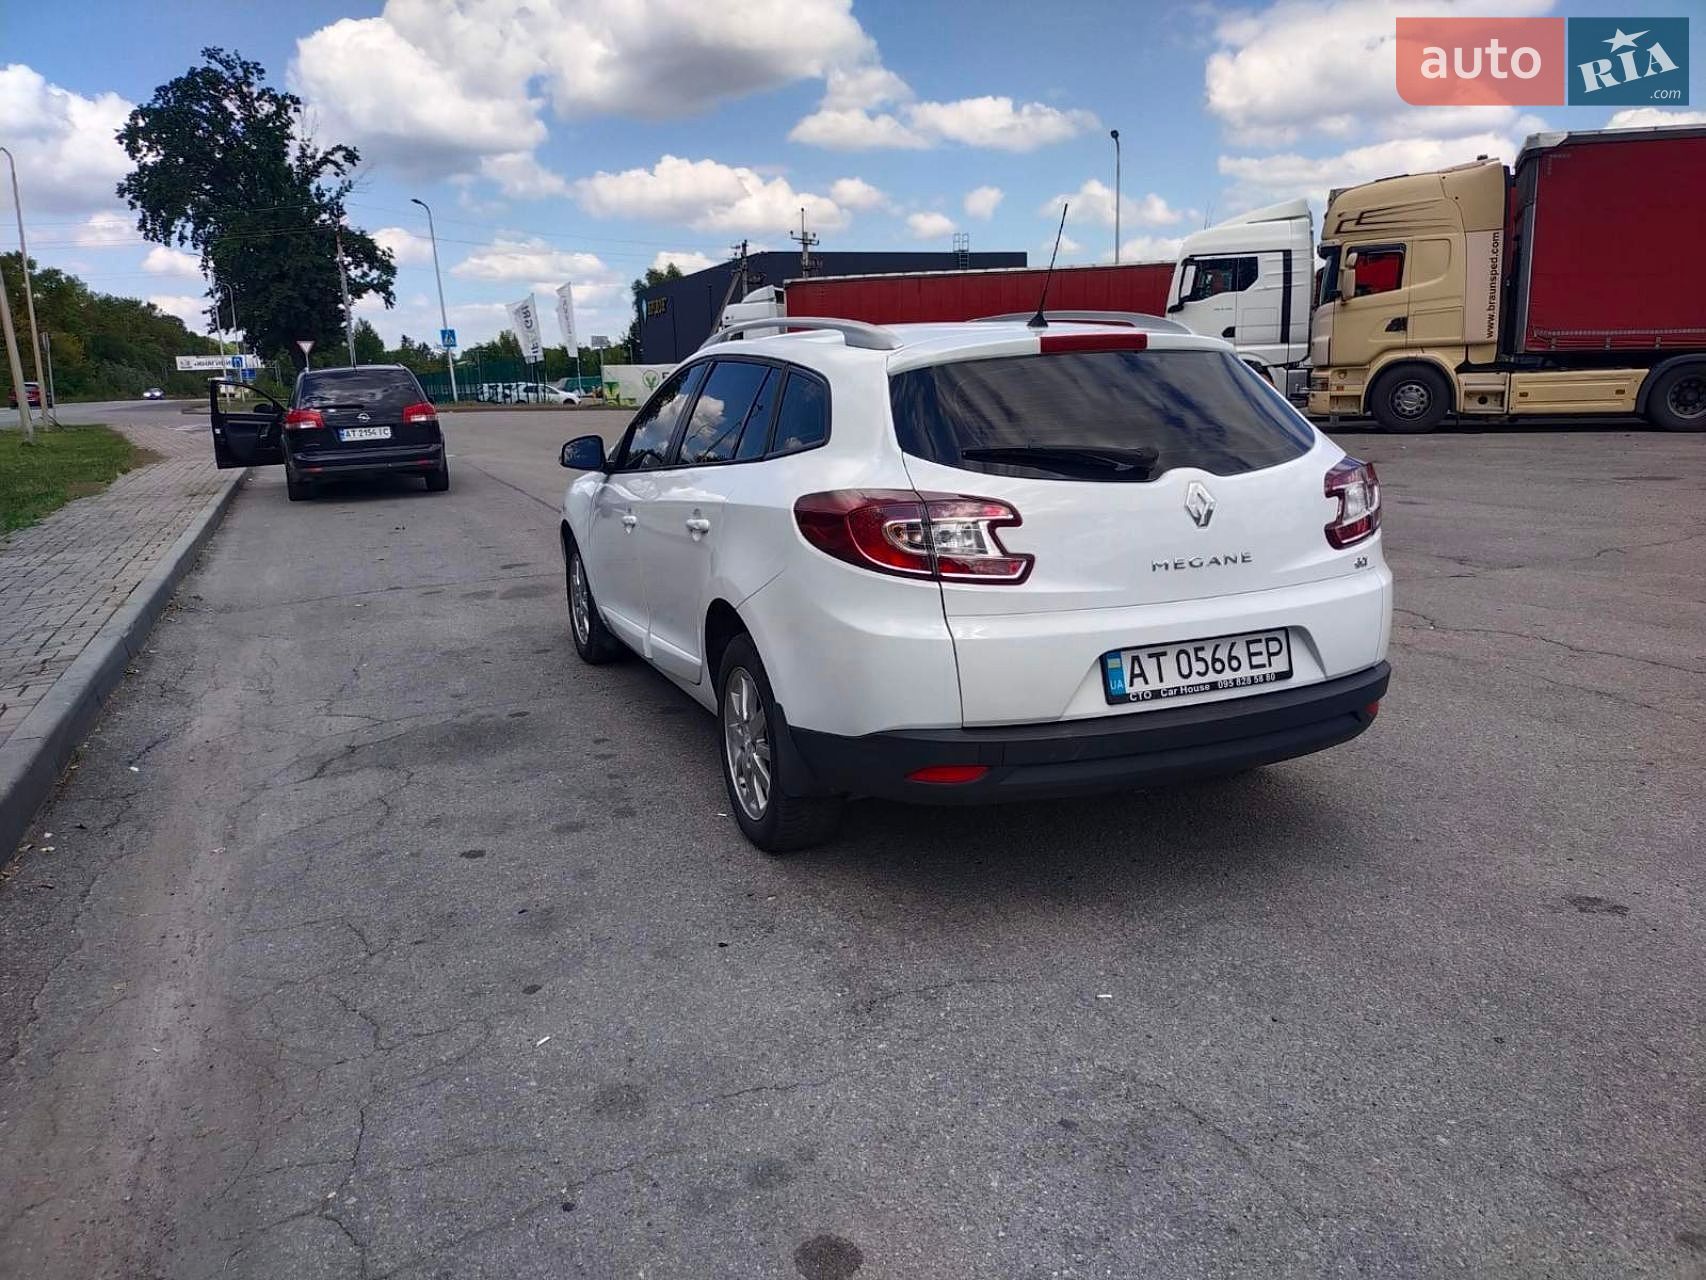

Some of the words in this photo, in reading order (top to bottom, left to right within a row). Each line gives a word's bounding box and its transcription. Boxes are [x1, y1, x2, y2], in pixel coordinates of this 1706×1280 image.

[1487, 231, 1500, 339] www.braunsped.com
[1152, 552, 1253, 571] MEGANE
[1129, 651, 1167, 687] AT
[1175, 642, 1242, 679] 0566
[1245, 636, 1283, 670] EP
[1110, 679, 1124, 690] UA
[1160, 687, 1177, 697] Car
[1180, 683, 1210, 695] House
